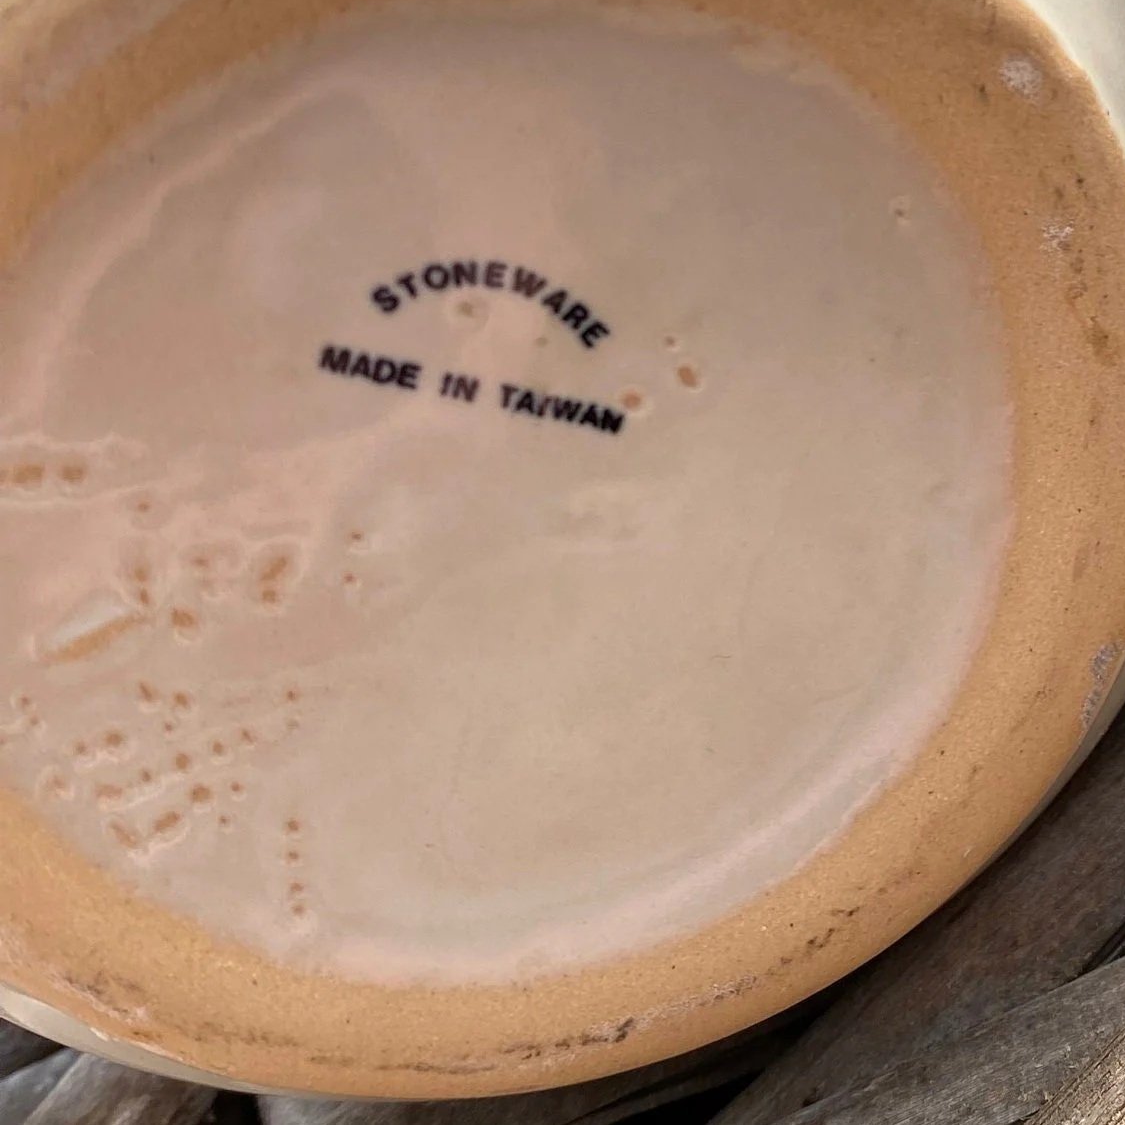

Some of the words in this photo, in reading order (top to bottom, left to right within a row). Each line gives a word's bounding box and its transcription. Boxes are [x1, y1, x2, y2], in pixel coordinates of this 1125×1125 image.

[371, 261, 610, 348] STONEWARE
[319, 345, 422, 390] MADE
[440, 372, 480, 403] IN
[500, 383, 625, 435] TAIWAN
